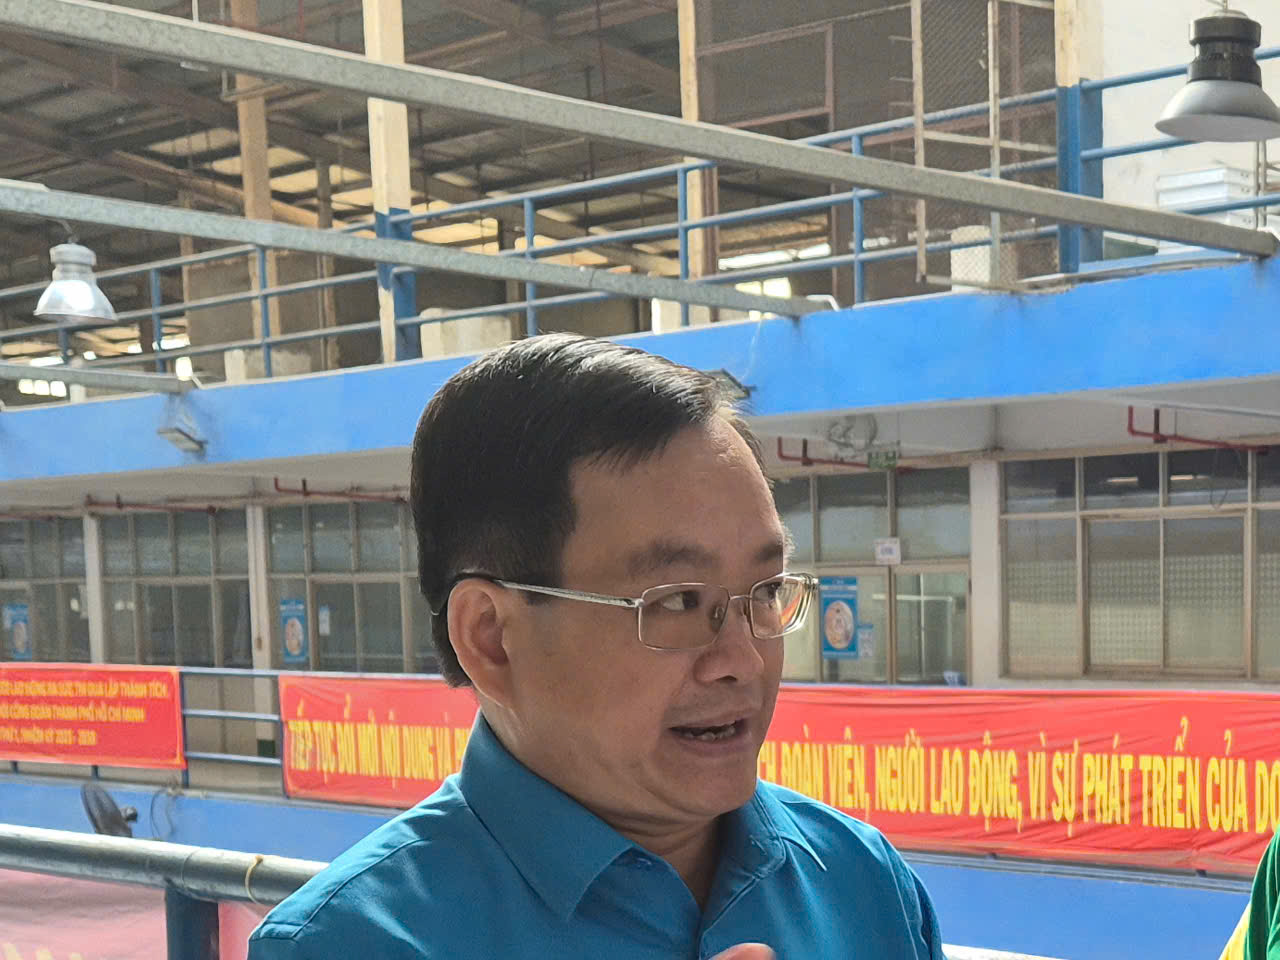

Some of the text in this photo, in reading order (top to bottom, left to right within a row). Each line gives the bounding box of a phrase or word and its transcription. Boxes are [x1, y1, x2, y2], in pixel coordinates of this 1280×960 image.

[930, 748, 965, 815] LAO
[1028, 731, 1047, 820] VÌ
[1051, 738, 1080, 837] SỰ
[1082, 733, 1133, 825] PHÁT
[1139, 716, 1200, 830] TRIỂN
[1206, 729, 1249, 833] CỦA
